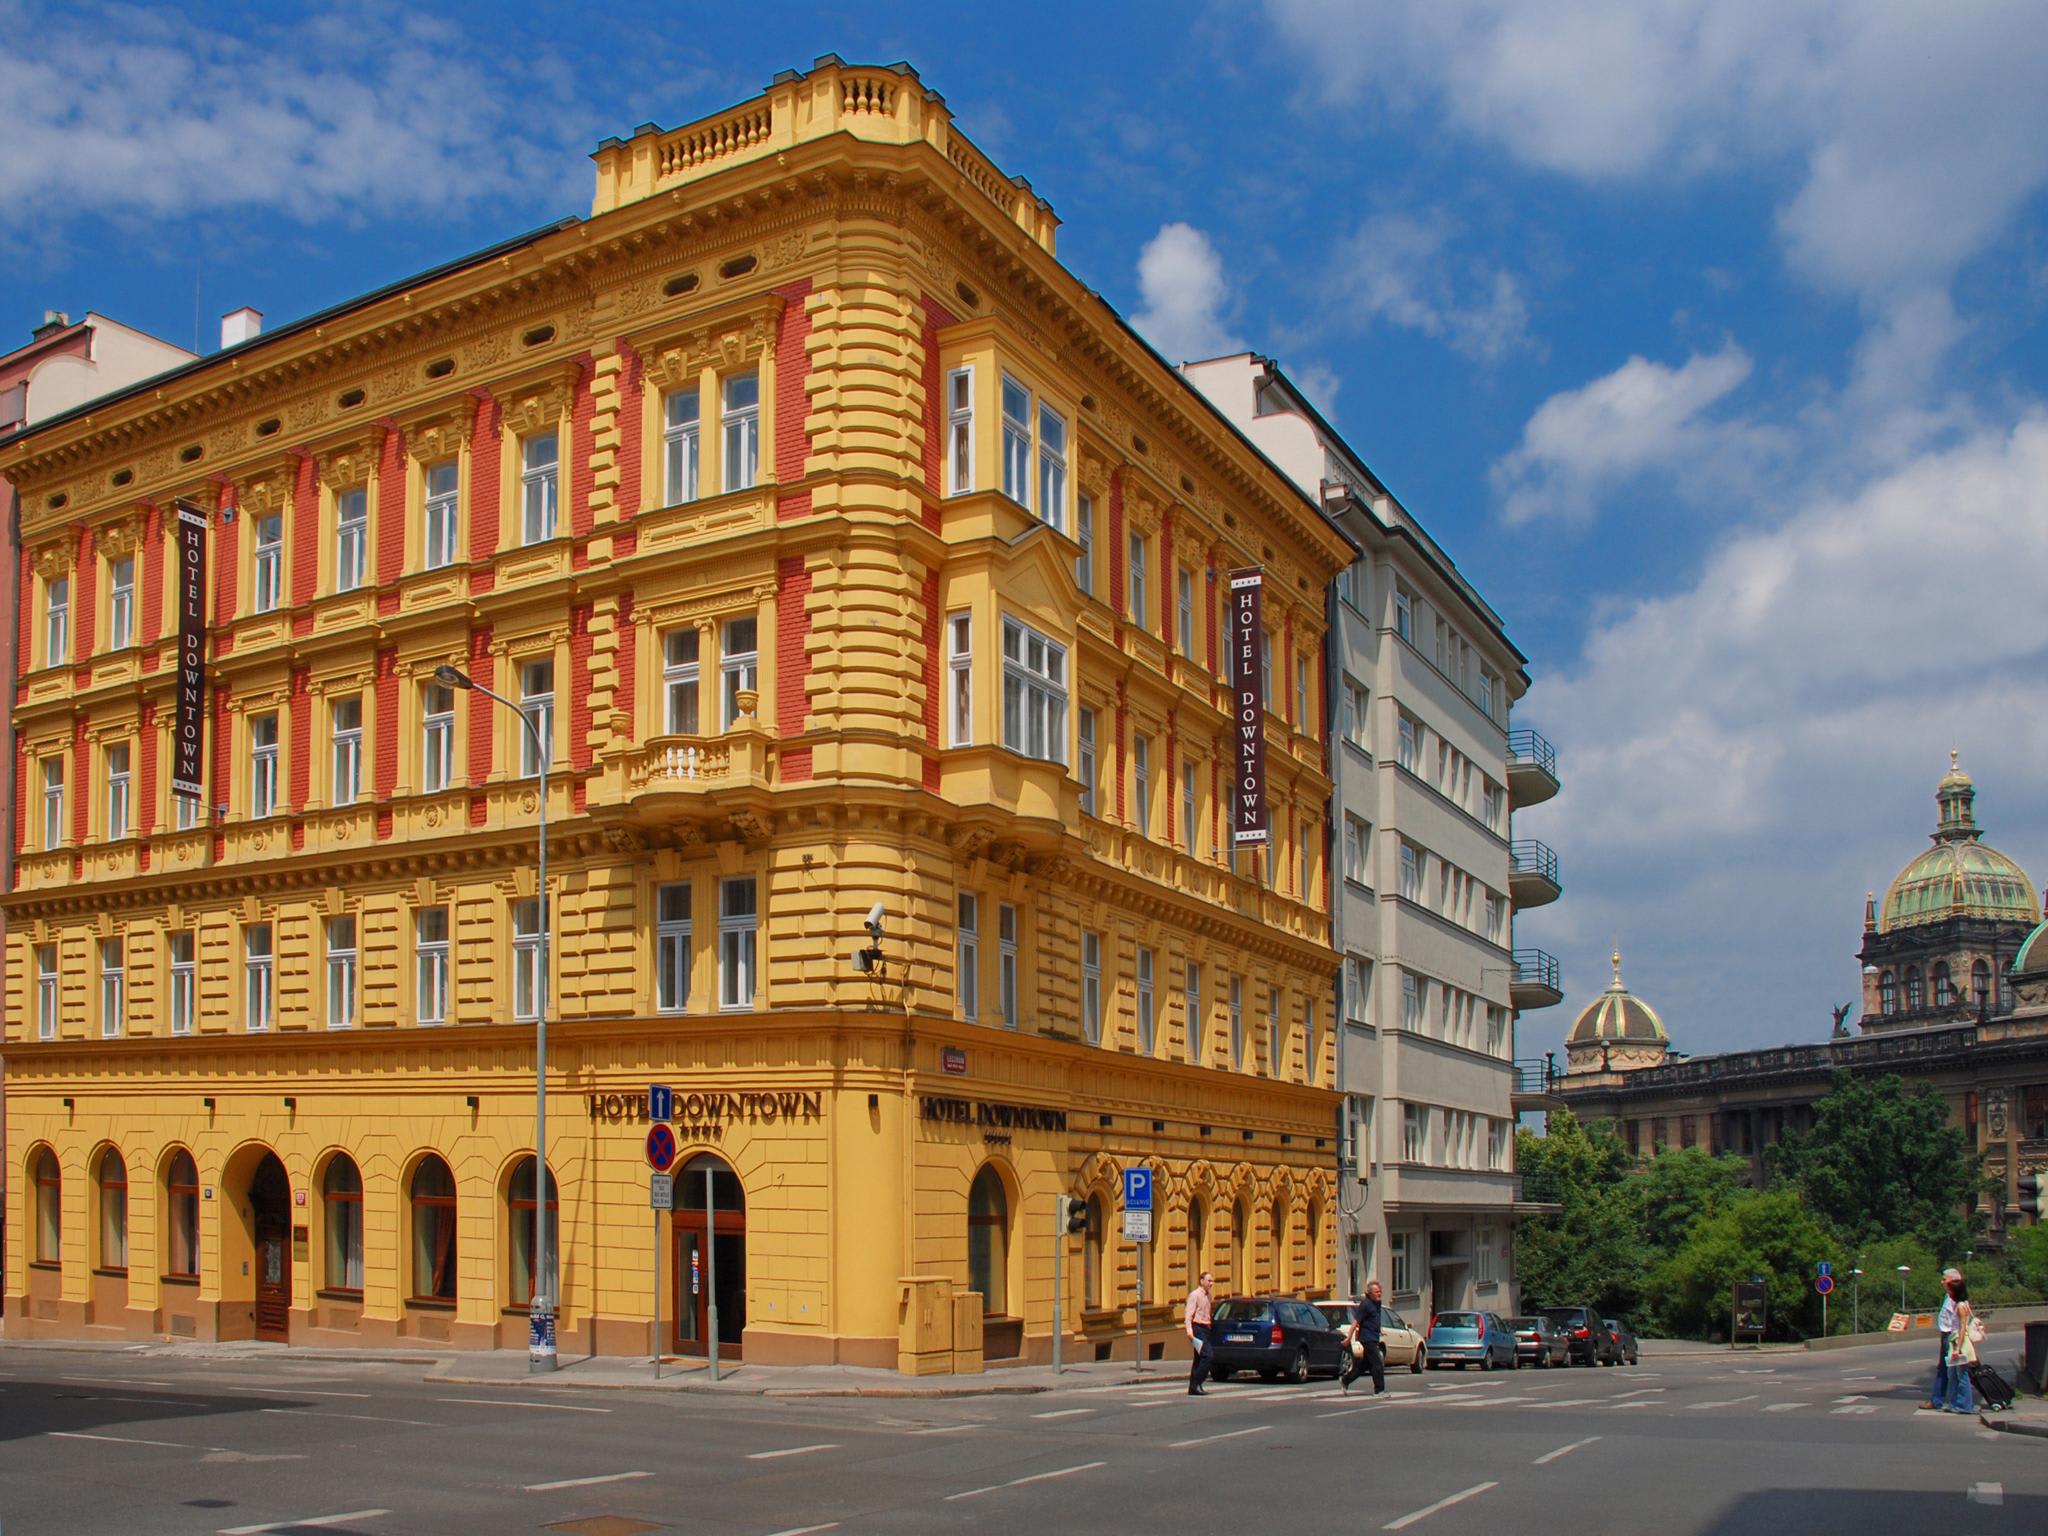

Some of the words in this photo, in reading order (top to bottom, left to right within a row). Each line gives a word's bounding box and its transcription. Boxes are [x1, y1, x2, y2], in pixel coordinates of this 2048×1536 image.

[187, 531, 199, 616] HOTEL
[1240, 594, 1253, 675] HOTEL
[182, 634, 199, 775] DOWNTOWN
[1242, 691, 1257, 824] DOWNTOWN
[589, 1094, 650, 1117] HOTE
[671, 1091, 821, 1120] DOWNTOWN
[920, 1096, 976, 1123] HOTEL
[977, 1103, 1066, 1132] DOWNTOWN
[1130, 1173, 1146, 1197] P
